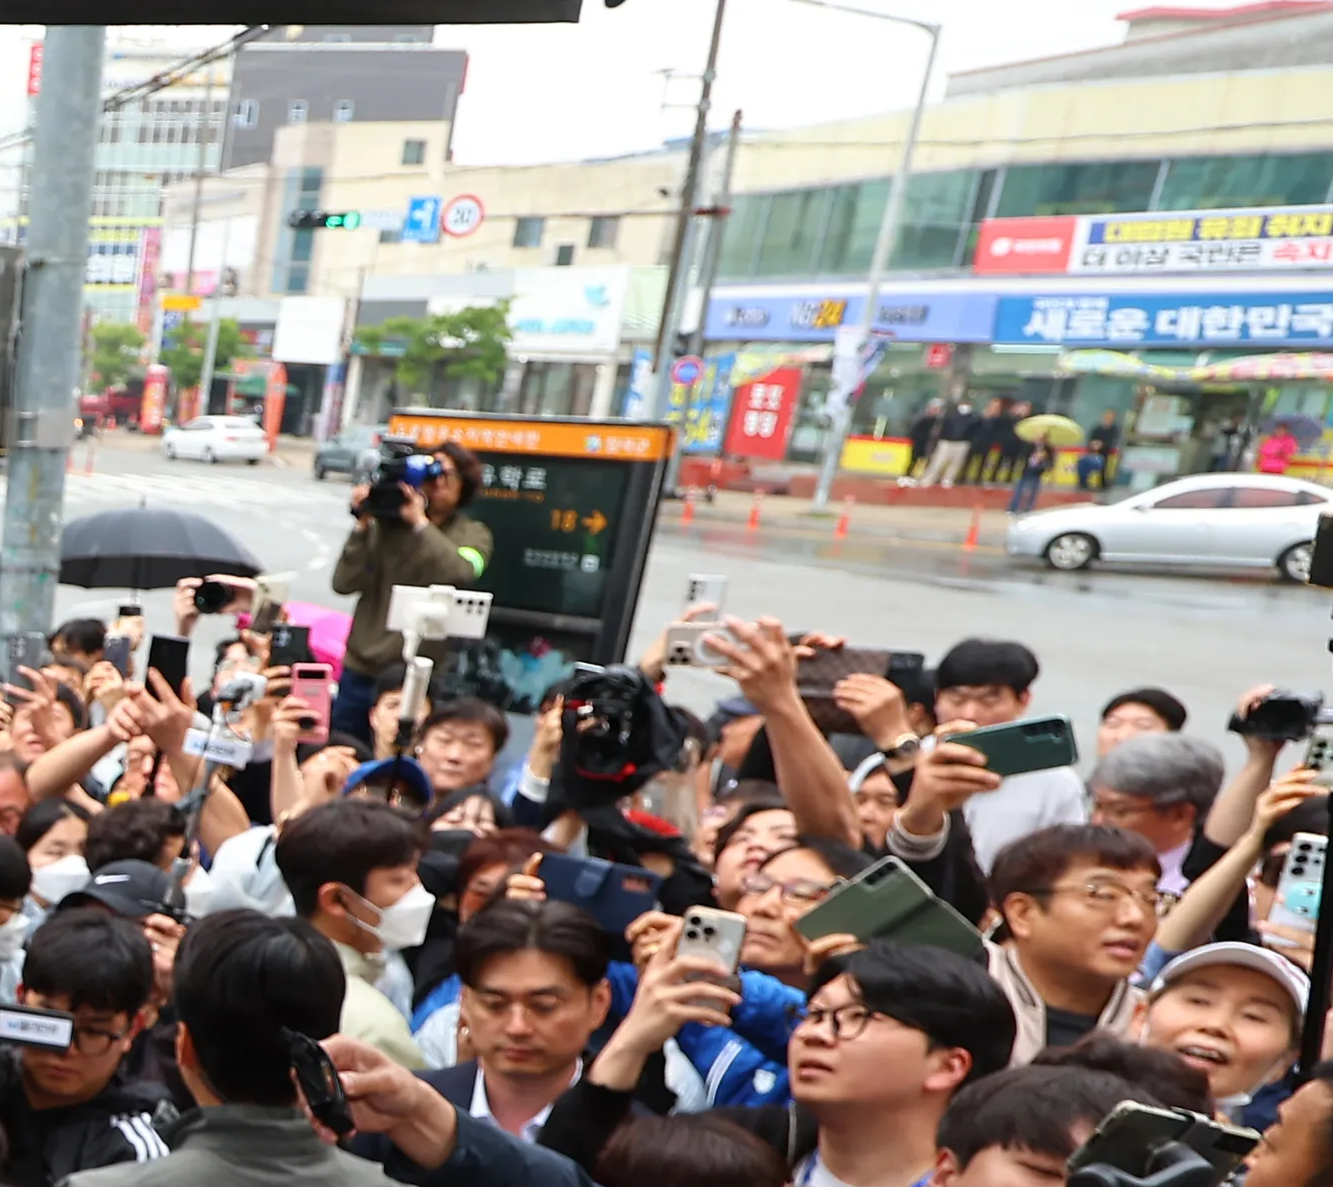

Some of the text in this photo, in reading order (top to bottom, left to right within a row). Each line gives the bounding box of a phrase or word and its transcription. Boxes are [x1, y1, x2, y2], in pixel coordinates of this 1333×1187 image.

[1083, 249, 1106, 266] 더
[1116, 246, 1169, 265] 이상
[1023, 303, 1333, 341] 새로운 대한민국
[551, 509, 579, 533] 18
